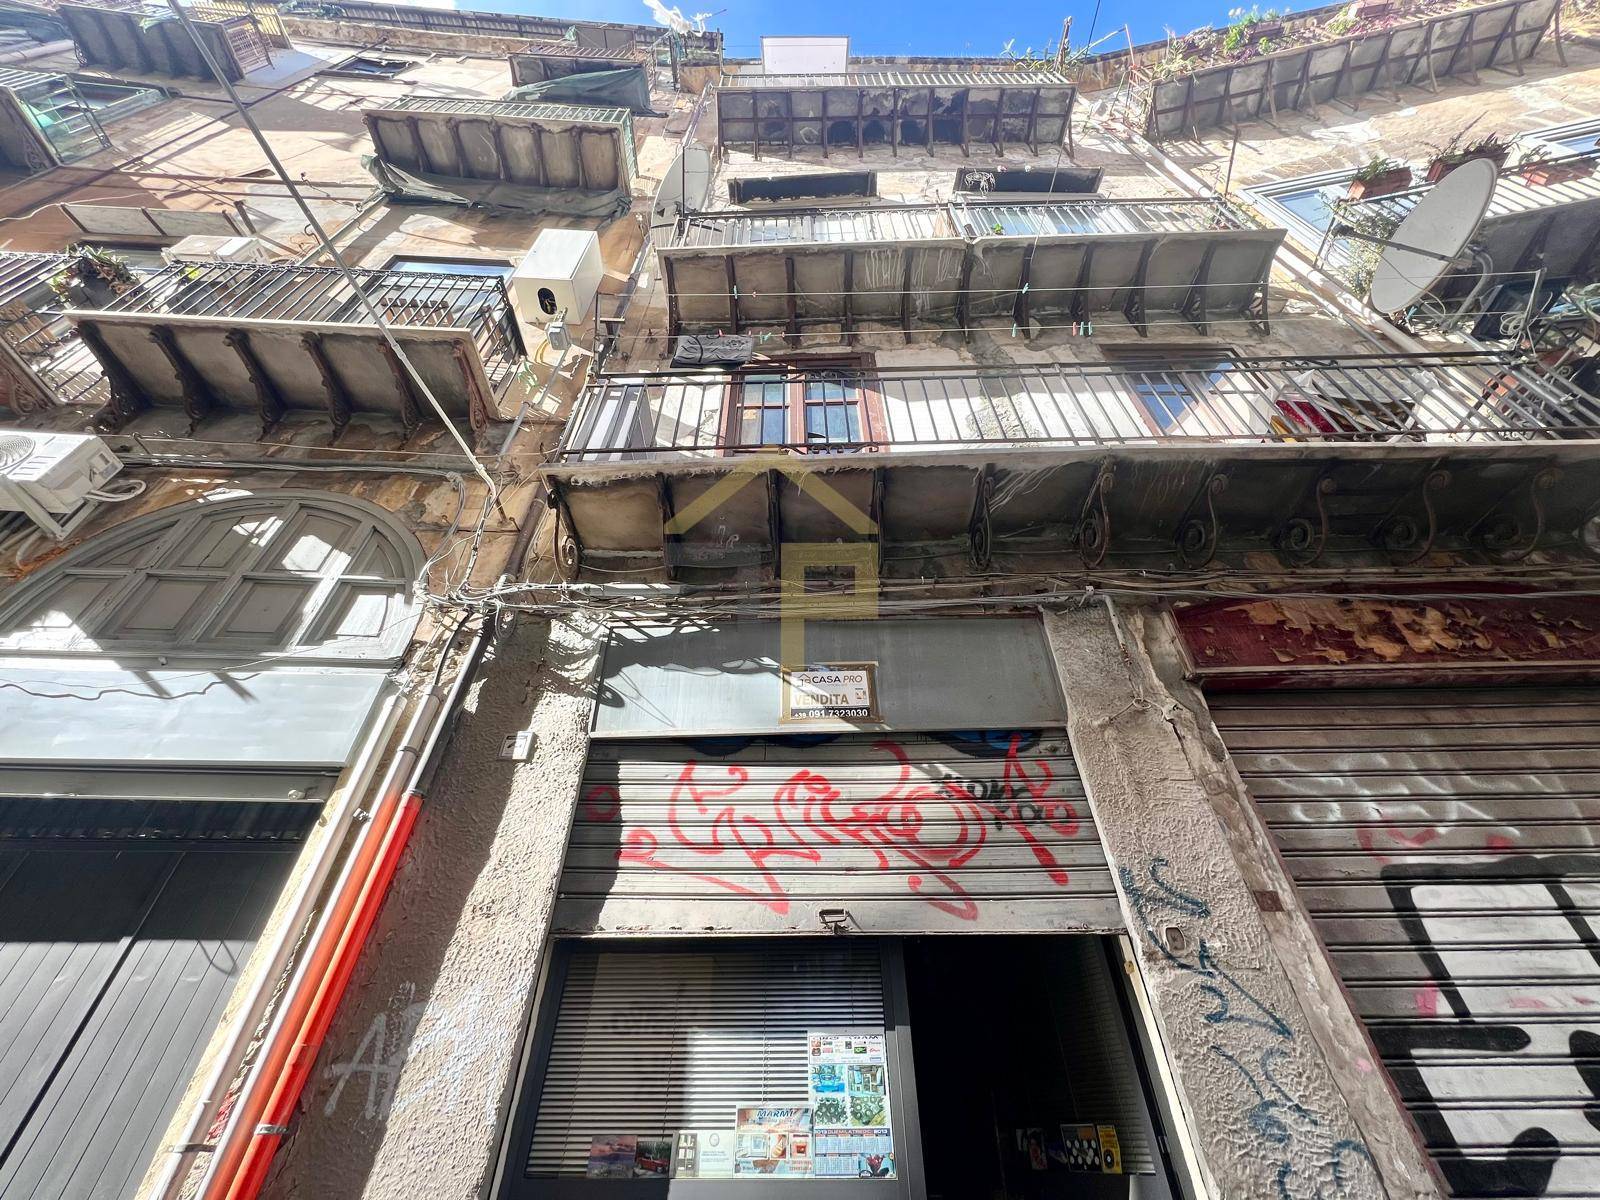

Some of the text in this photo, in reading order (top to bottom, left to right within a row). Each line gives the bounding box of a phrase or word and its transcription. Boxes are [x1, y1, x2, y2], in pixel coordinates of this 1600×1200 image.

[812, 675, 863, 683] CASA PRO
[796, 694, 849, 705] VENDITA
